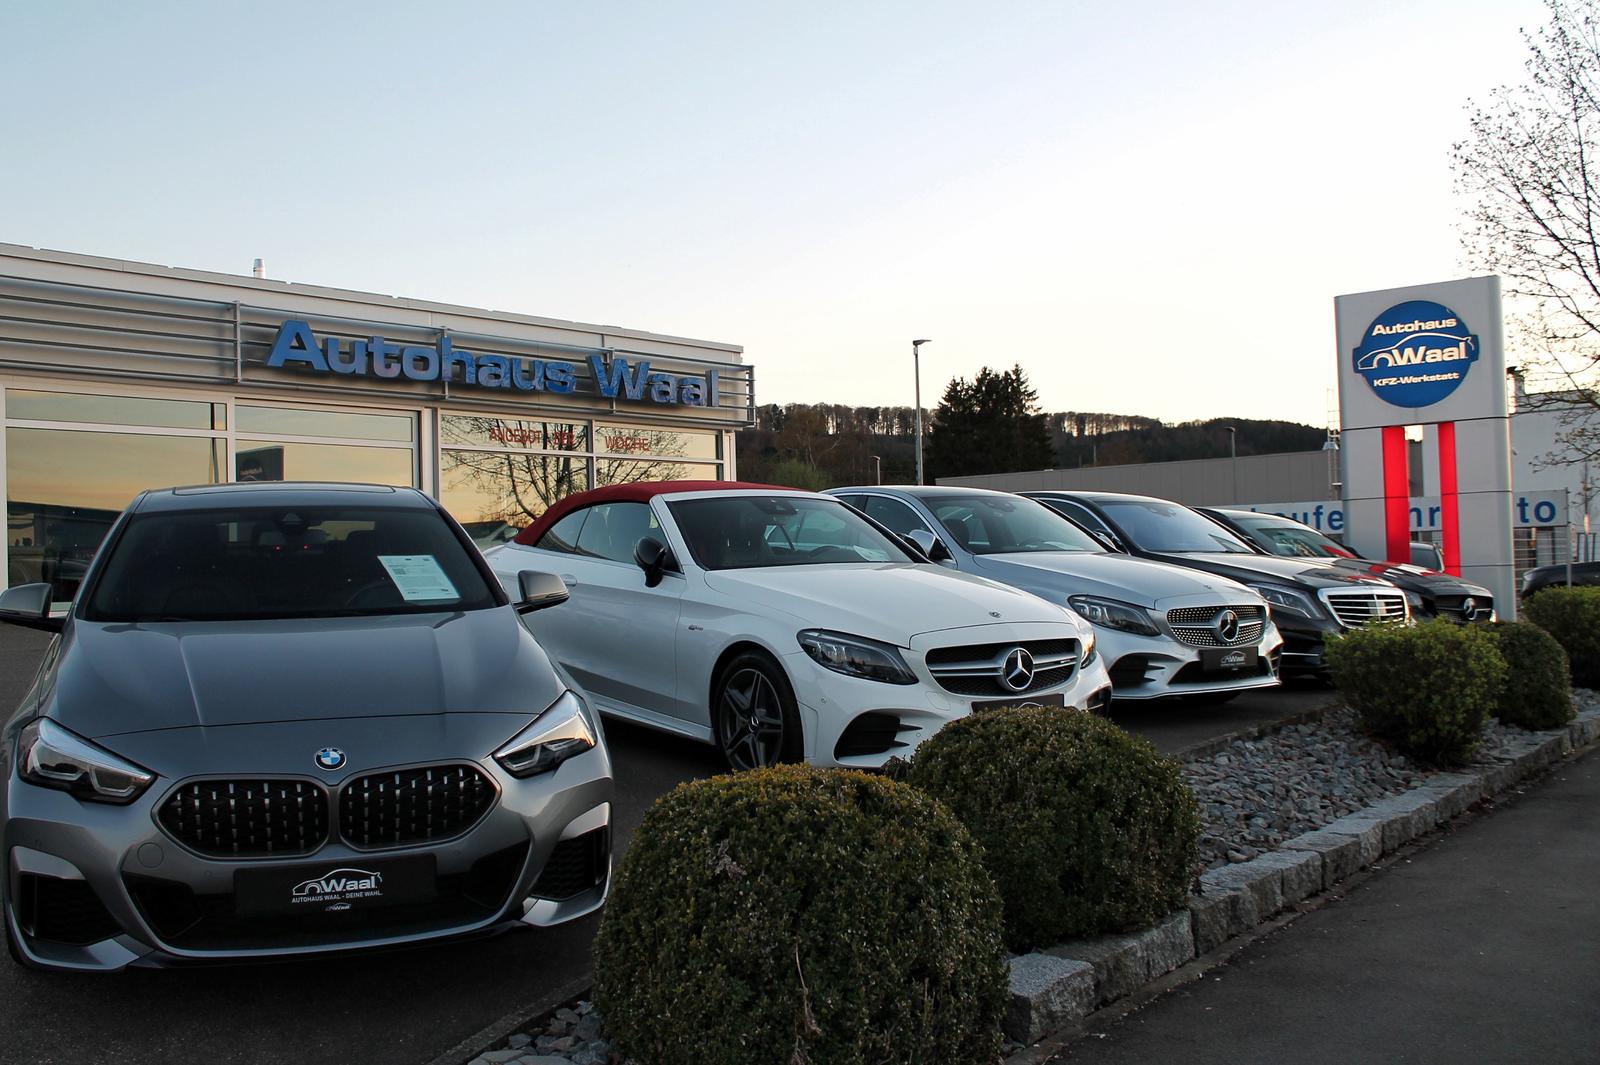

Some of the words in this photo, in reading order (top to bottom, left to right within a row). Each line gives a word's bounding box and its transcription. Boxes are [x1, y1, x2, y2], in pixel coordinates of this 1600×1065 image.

[1372, 318, 1457, 336] Autohaus
[266, 320, 576, 393] Autohaus
[587, 355, 719, 407] Waal
[1391, 342, 1467, 367] Waal
[1373, 372, 1460, 387] KFZ-Werkstatt
[490, 426, 542, 444] ANGEBOT
[605, 435, 650, 451] WOCHE
[1516, 497, 1557, 523] to
[320, 876, 375, 892] Waal
[292, 894, 323, 903] AUTOHAUS
